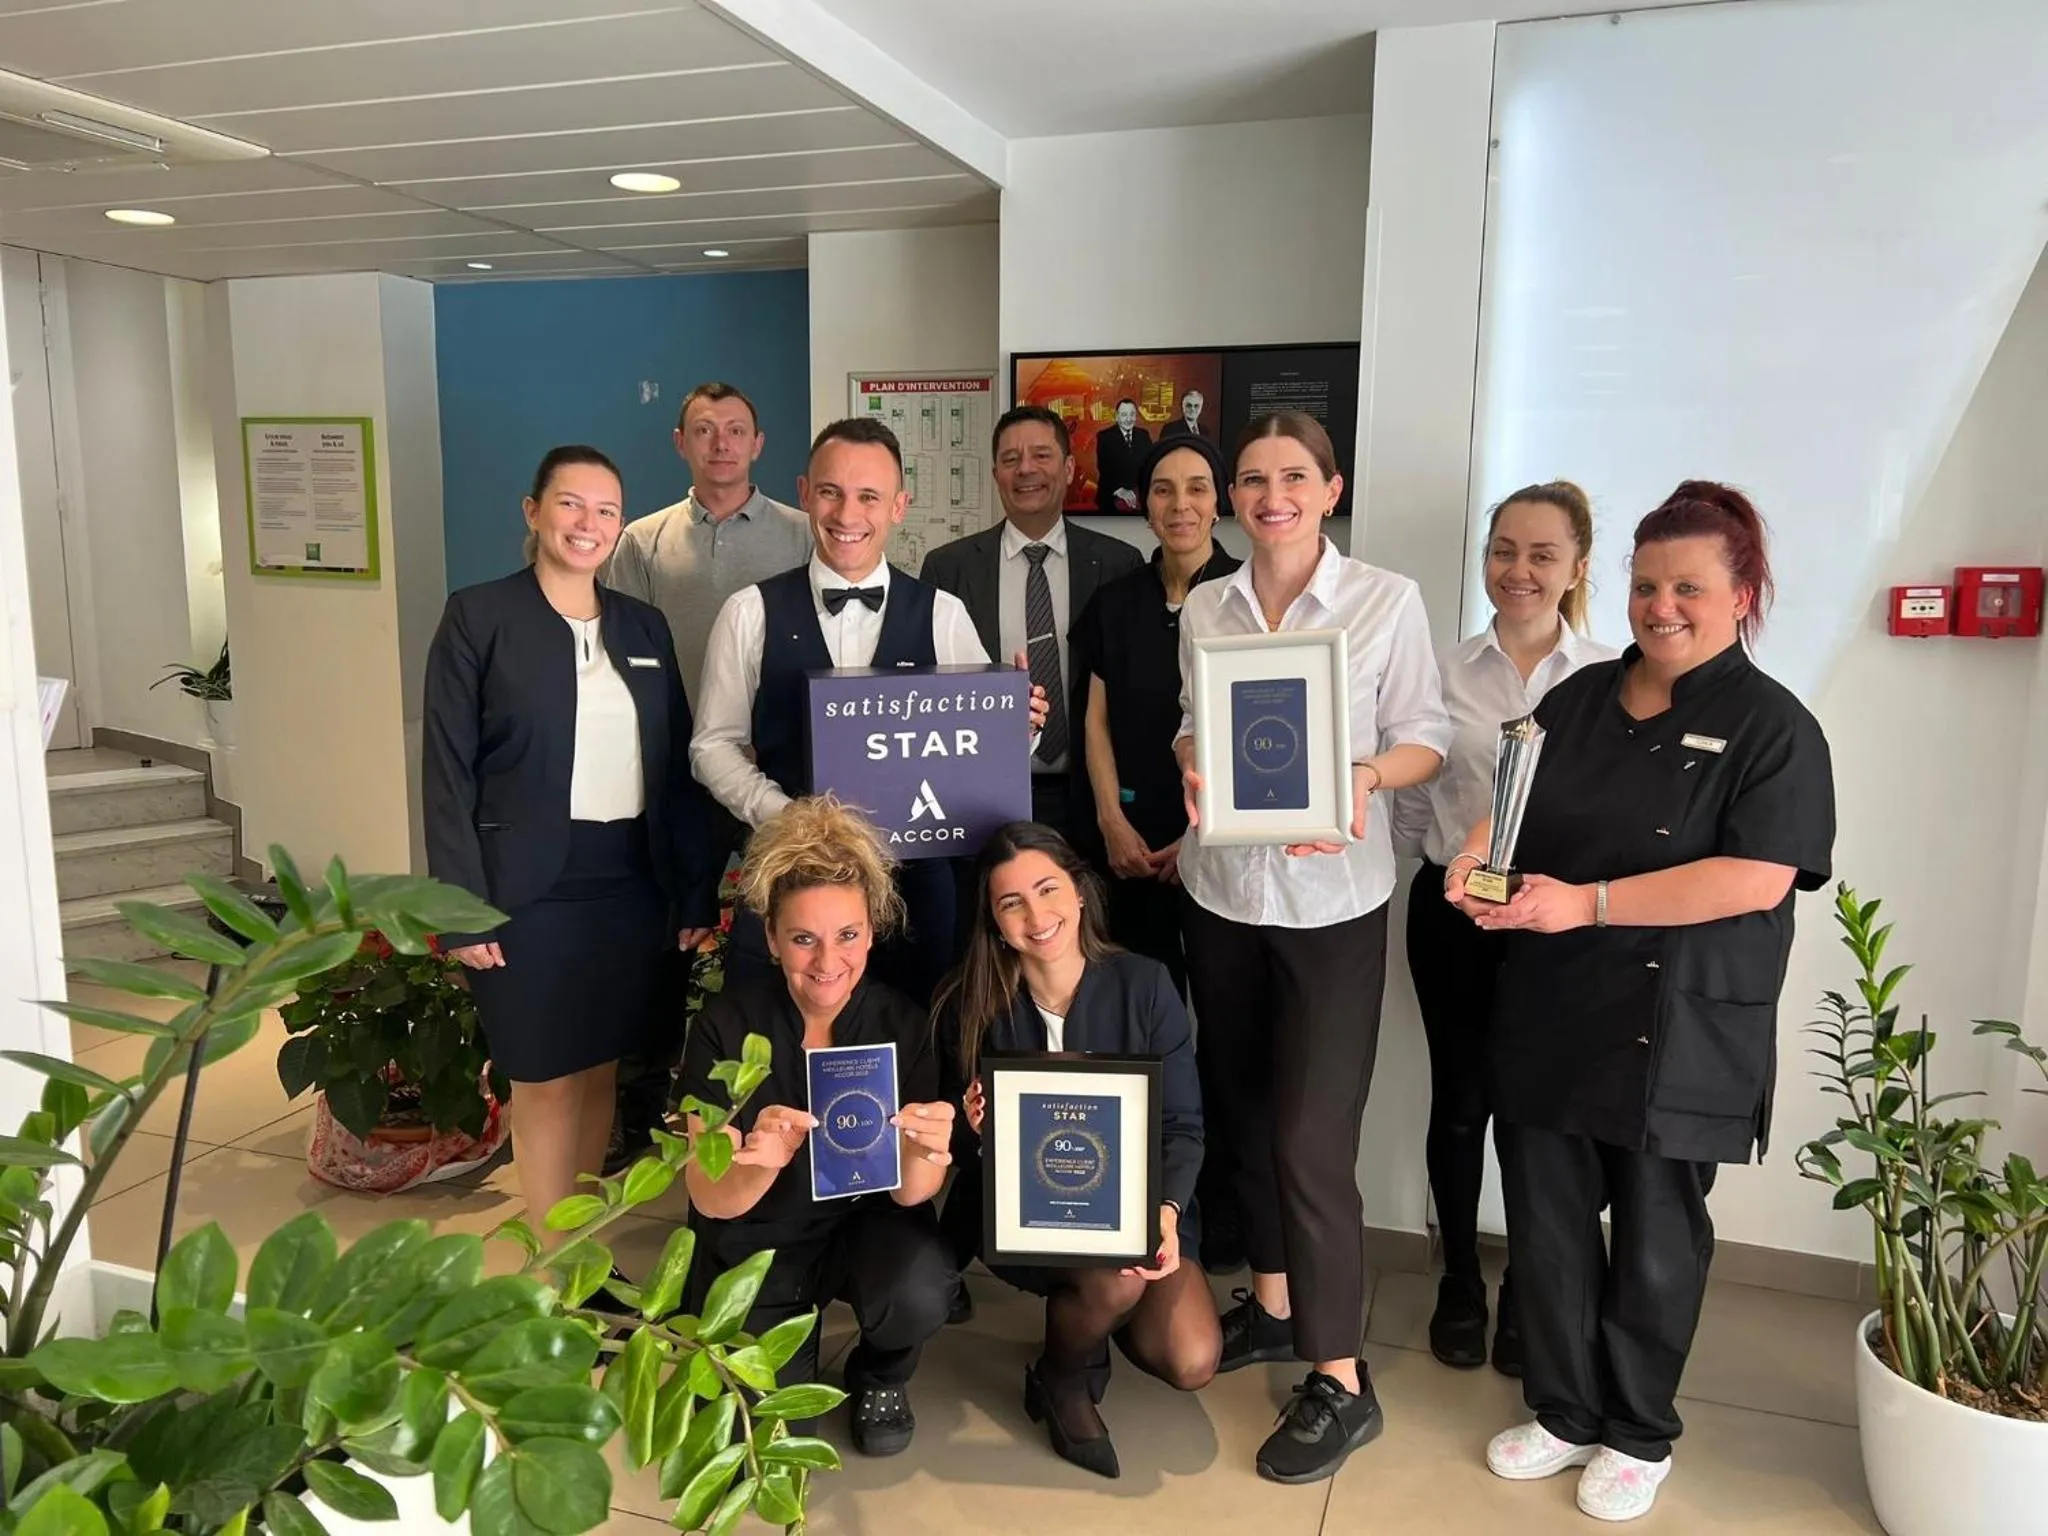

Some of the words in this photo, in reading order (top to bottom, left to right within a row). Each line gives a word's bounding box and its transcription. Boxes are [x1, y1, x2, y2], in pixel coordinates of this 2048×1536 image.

[869, 383, 896, 391] PLAN
[898, 381, 980, 391] D'INTERVENTION
[825, 690, 1015, 720] satisfaction
[866, 729, 979, 760] STAR
[1253, 736, 1273, 751] 90
[890, 828, 965, 844] ACCOR
[1042, 1102, 1099, 1112] satisfaction
[836, 1114, 857, 1131] 90
[1053, 1111, 1087, 1121] STAR
[1054, 1139, 1072, 1152] 90
